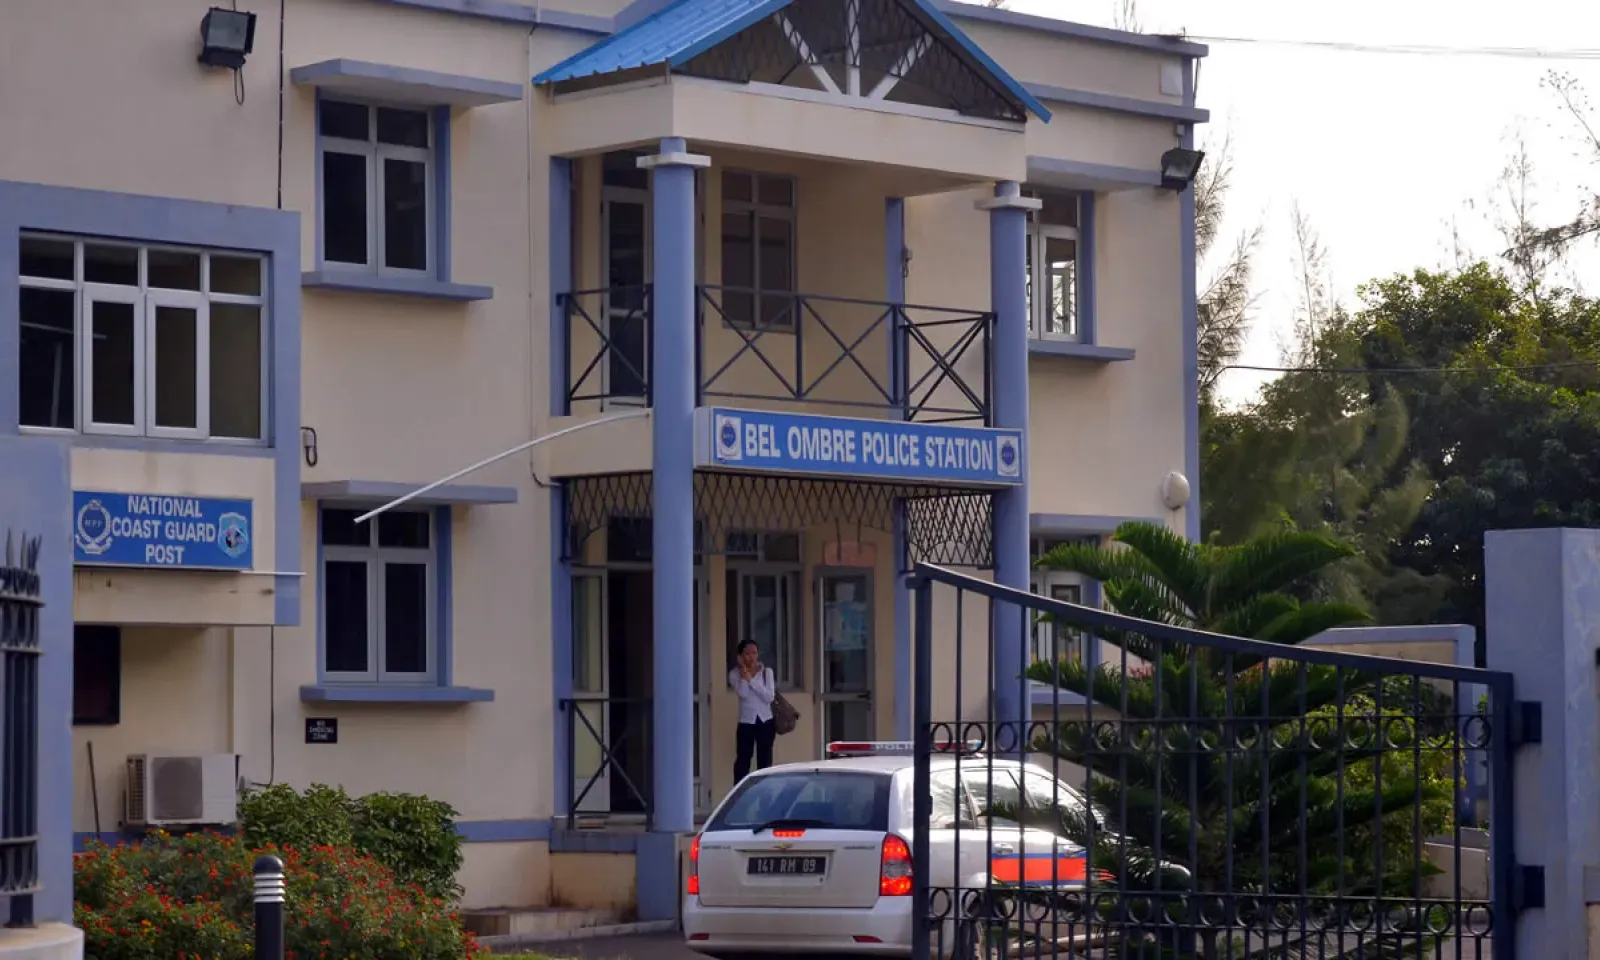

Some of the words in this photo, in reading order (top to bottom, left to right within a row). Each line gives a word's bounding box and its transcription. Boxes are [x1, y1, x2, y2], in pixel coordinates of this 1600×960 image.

[745, 423, 781, 458] BEL
[787, 426, 857, 463] OMBRE
[862, 431, 920, 467] POLICE
[925, 435, 994, 471] STATION
[127, 495, 203, 518] NATIONAL
[111, 516, 162, 540] COAST
[165, 520, 216, 543] GUARD
[145, 543, 185, 565] POST
[757, 859, 774, 873] 141
[780, 859, 796, 873] RM
[802, 859, 817, 872] 09
